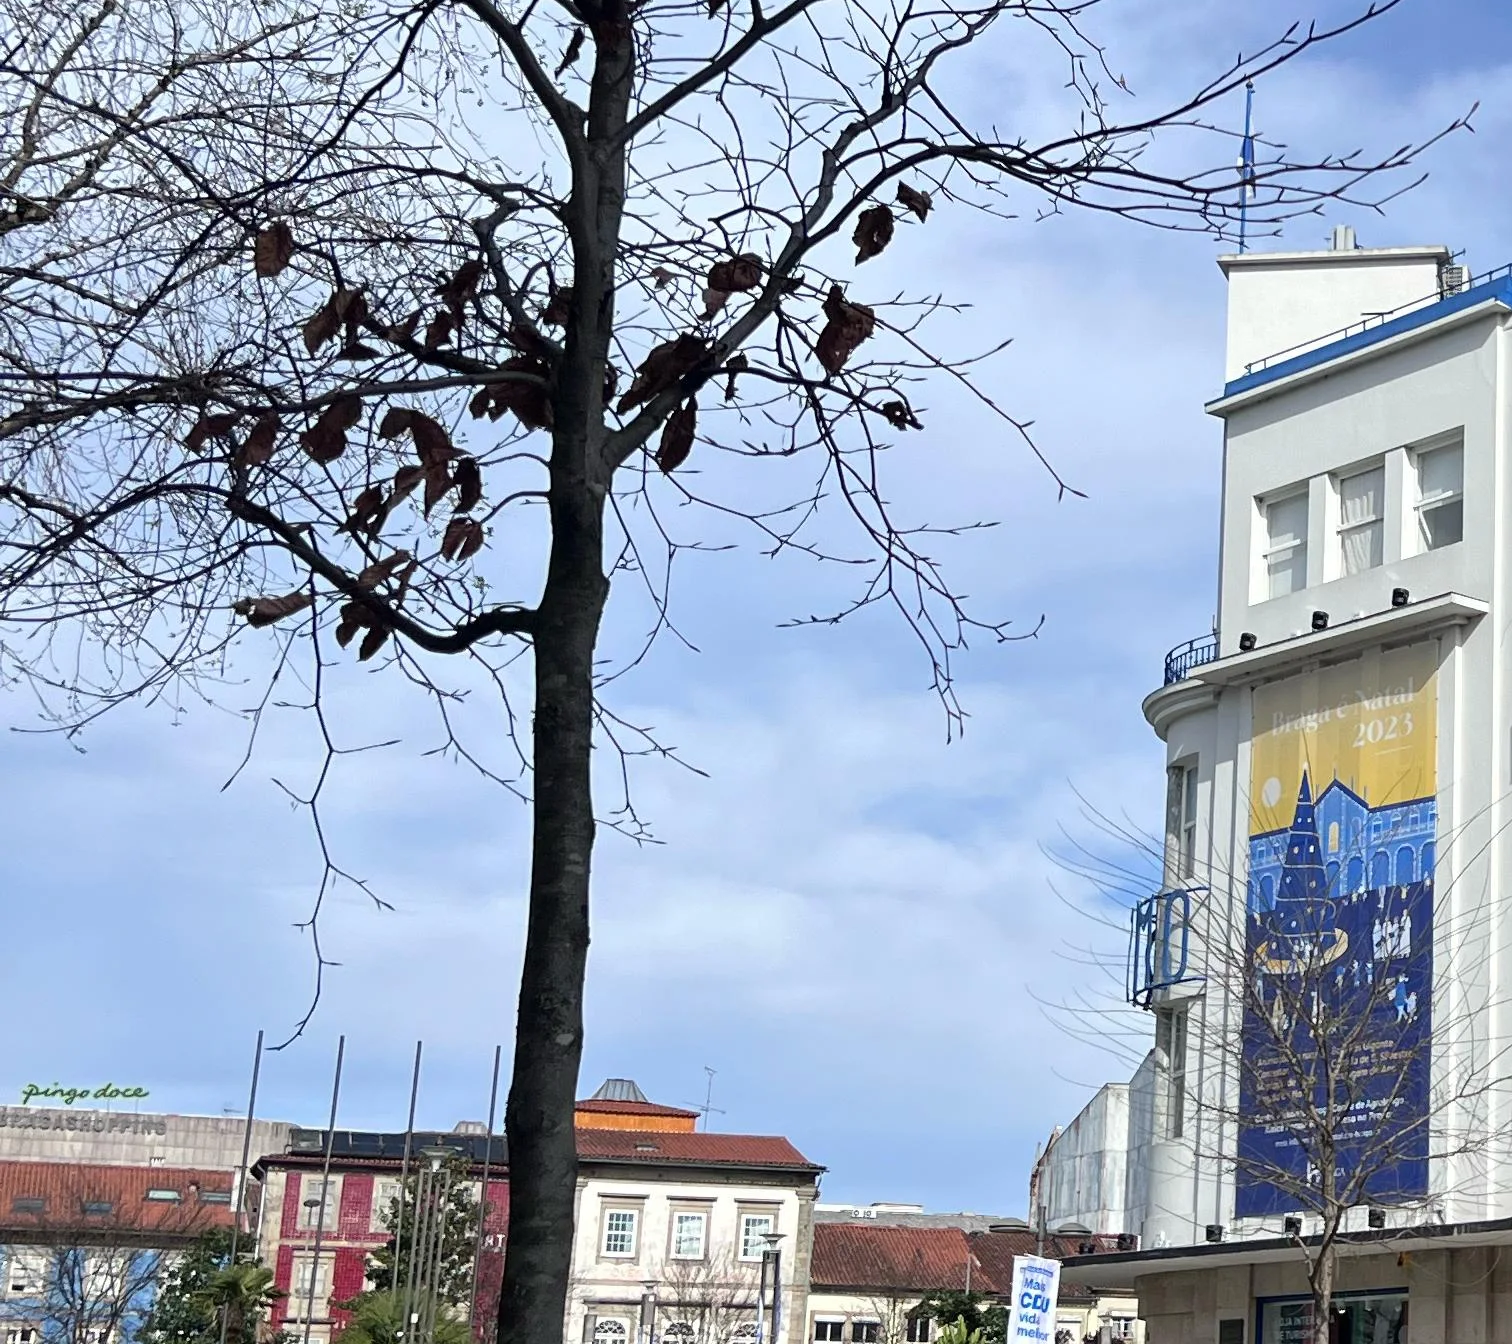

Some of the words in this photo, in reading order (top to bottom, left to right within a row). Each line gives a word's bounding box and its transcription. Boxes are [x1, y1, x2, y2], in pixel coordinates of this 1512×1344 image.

[1272, 708, 1331, 737] Braga
[1354, 676, 1415, 717] Natal
[1352, 712, 1414, 748] 2023
[23, 1082, 90, 1105] pingo
[94, 1082, 149, 1099] doce
